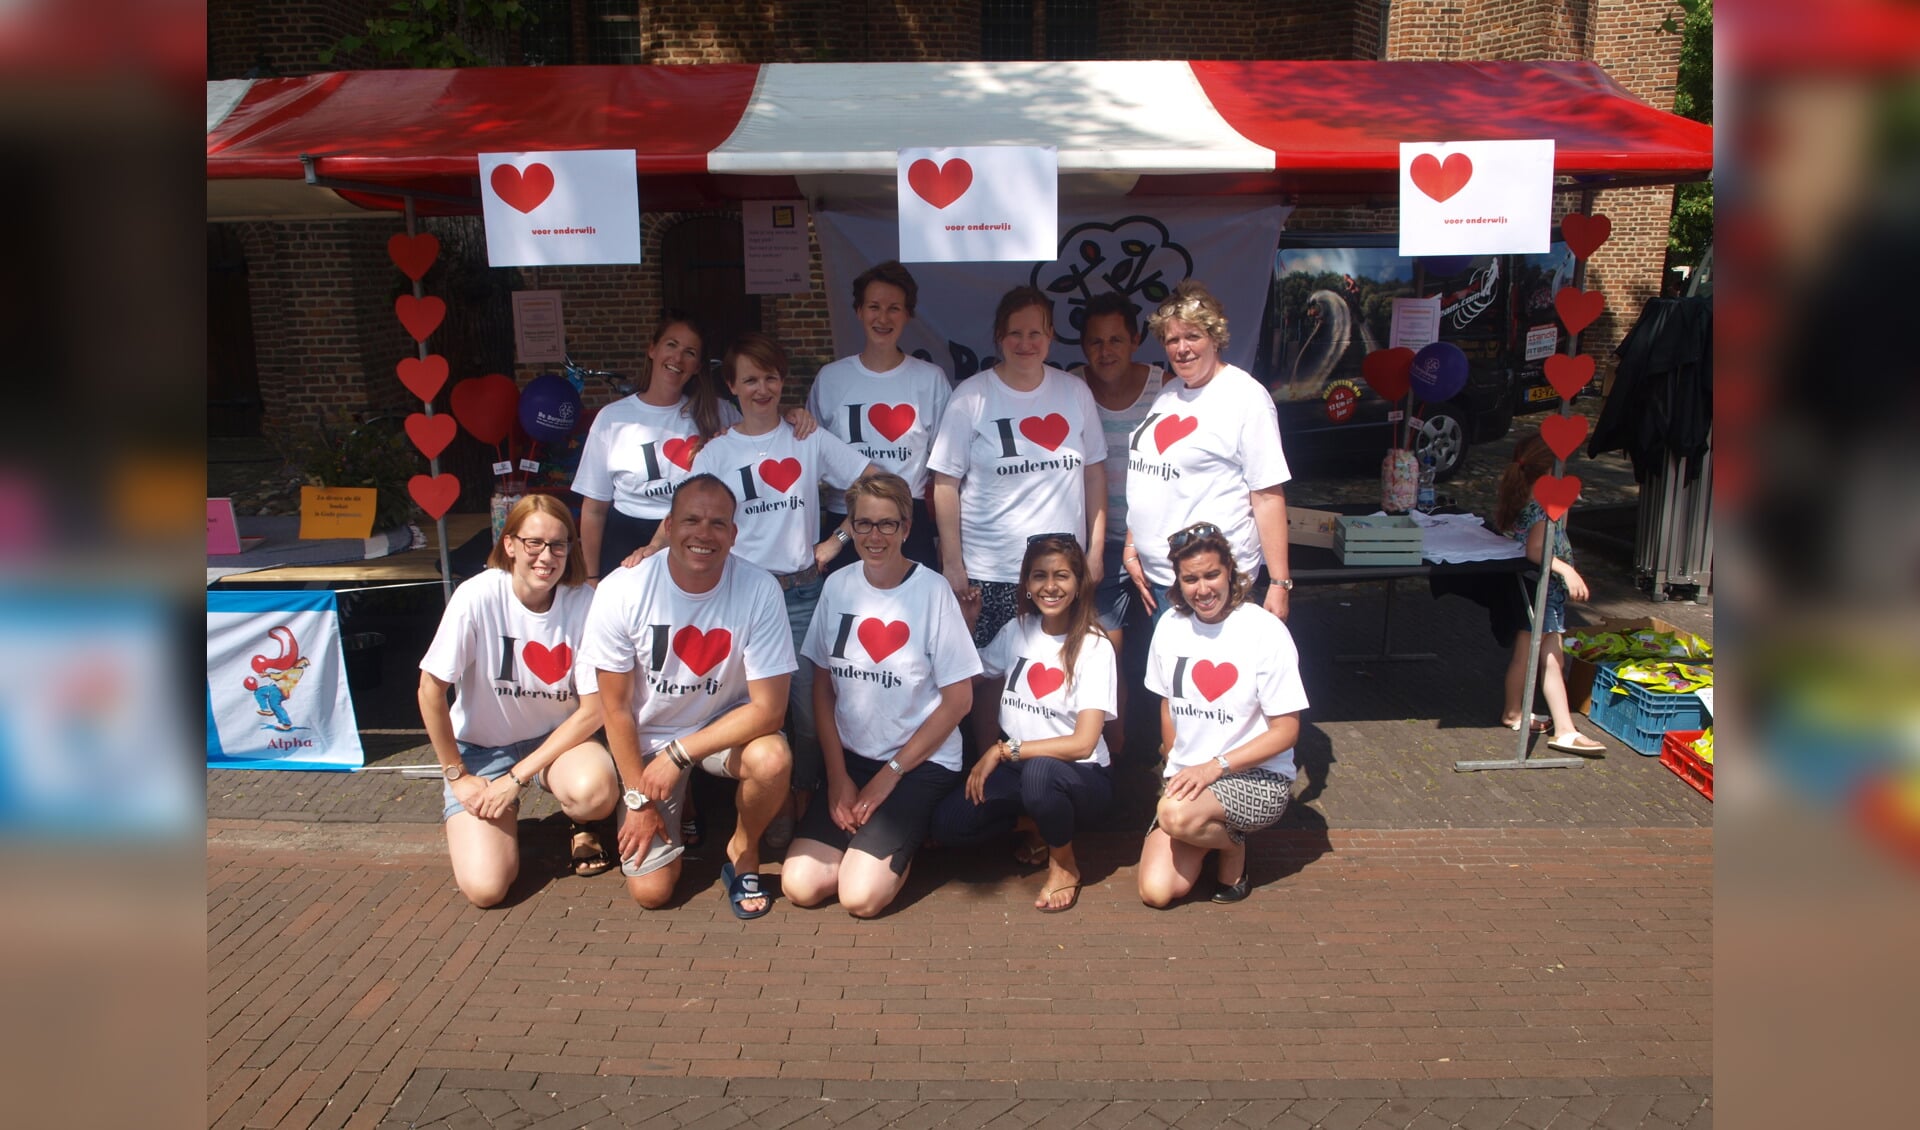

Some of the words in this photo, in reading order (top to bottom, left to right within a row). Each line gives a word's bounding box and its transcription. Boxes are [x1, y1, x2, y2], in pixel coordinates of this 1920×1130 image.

[553, 226, 596, 235] onderwijs
[967, 222, 1011, 231] onderwijs
[1466, 216, 1508, 225] onderwijs
[843, 403, 868, 445] I
[990, 417, 1024, 458] I
[641, 440, 667, 482] I
[996, 455, 1081, 476] onderwijs
[1128, 458, 1181, 481] nderwijs
[736, 463, 763, 502] I
[745, 495, 805, 516] onderwijs
[647, 624, 672, 673] I
[829, 612, 860, 660] I
[494, 636, 521, 682] I
[1004, 656, 1030, 693] I
[1172, 656, 1192, 699] I
[1001, 697, 1057, 720] onderwijs
[267, 738, 313, 751] Alpha
